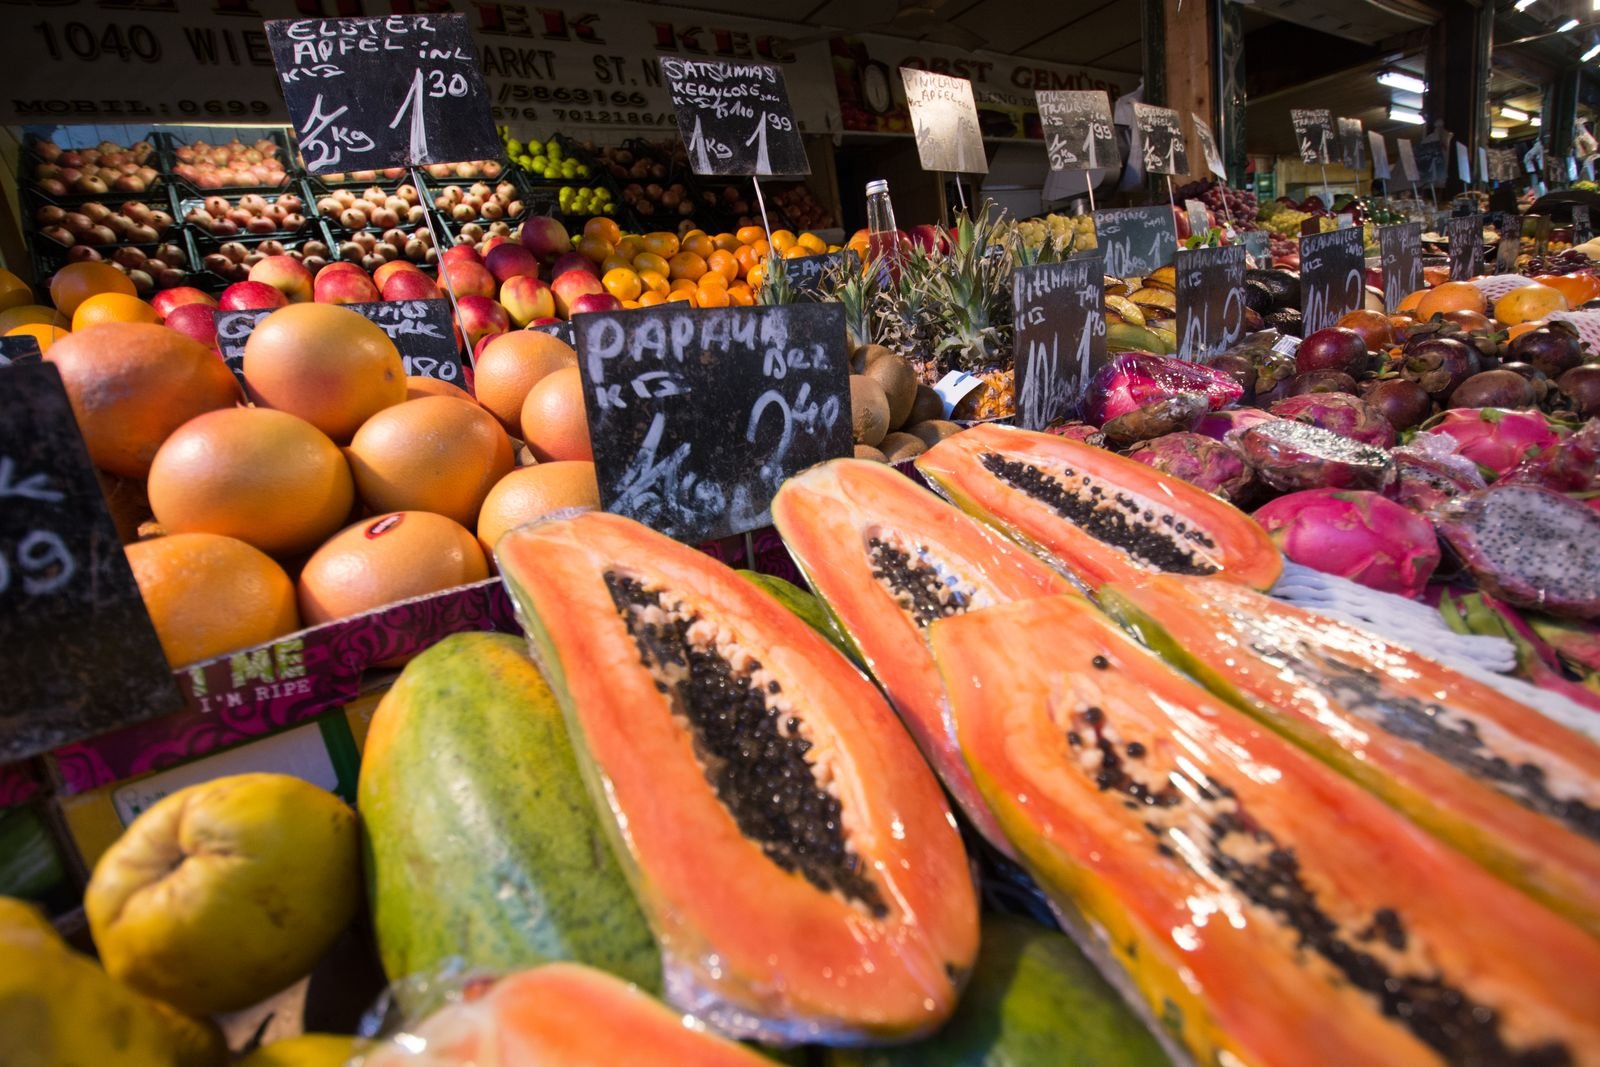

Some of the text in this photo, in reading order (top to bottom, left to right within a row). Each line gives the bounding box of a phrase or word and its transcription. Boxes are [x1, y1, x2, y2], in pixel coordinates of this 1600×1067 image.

[287, 15, 435, 40] ELSTER
[34, 20, 161, 63] 1040
[182, 27, 271, 66] WIE
[482, 46, 556, 80] ARKT
[294, 37, 403, 64] APFEL
[664, 60, 776, 84] SATSUMAS
[671, 82, 760, 100] KERNLOSE
[256, 679, 311, 701] RIPE
